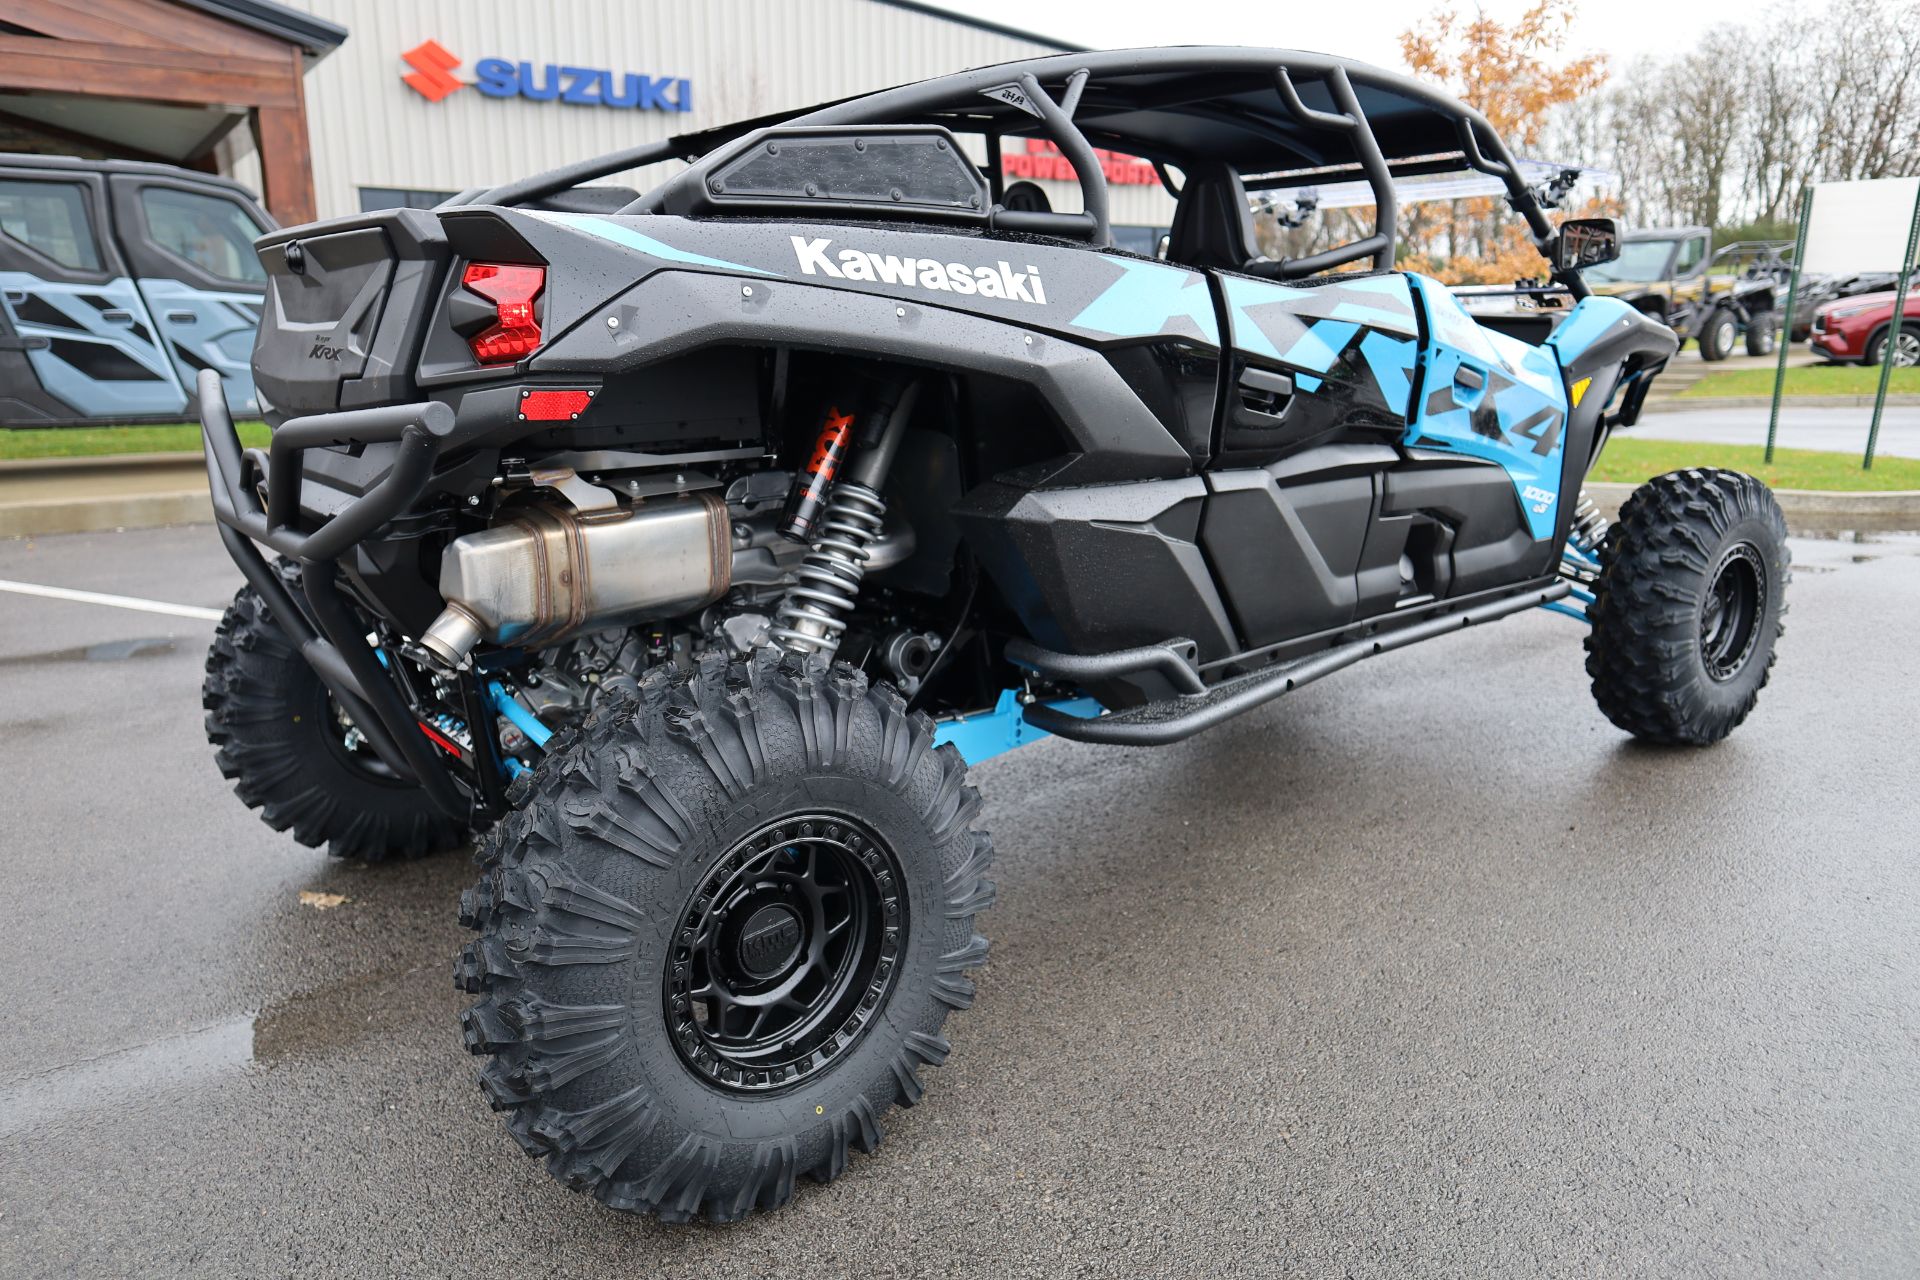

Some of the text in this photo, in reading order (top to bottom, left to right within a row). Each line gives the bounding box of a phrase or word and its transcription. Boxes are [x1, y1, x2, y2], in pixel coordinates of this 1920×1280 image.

[475, 58, 692, 112] SUZUKI
[790, 236, 1047, 305] Kawasaki
[309, 344, 344, 361] KRX
[805, 405, 855, 481] FOX
[1522, 485, 1556, 505] 1000
